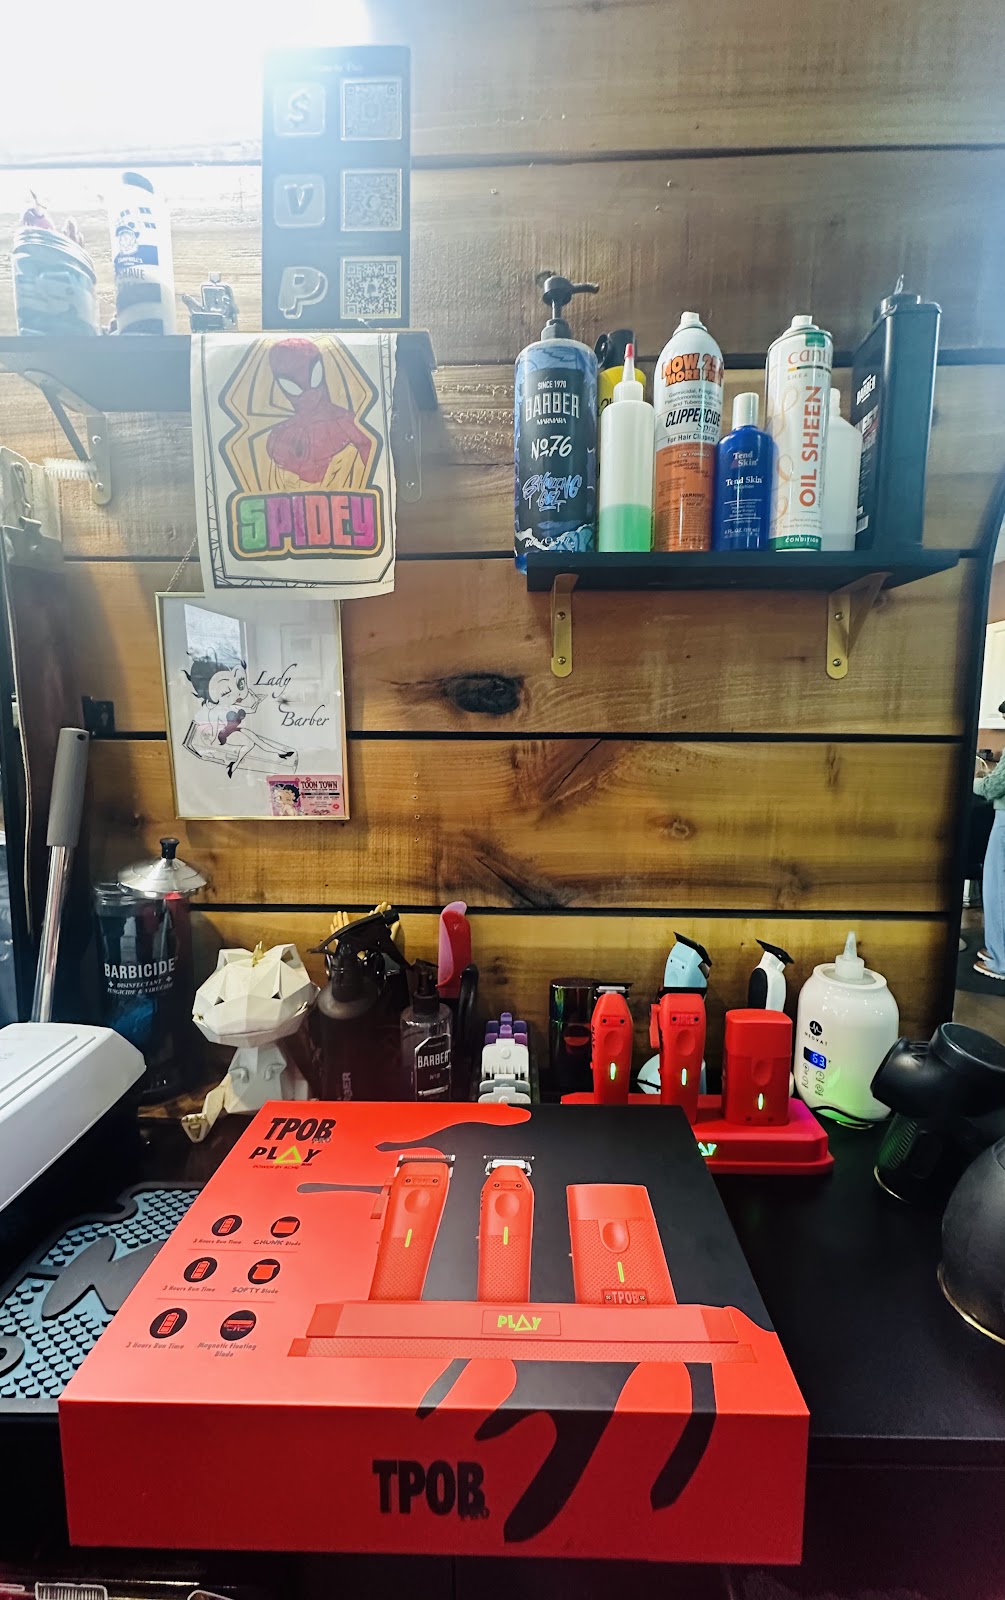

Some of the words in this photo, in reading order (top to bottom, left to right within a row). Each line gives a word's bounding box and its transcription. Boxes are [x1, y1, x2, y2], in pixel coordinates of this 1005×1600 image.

[661, 353, 700, 379] NOW
[537, 381, 553, 390] SINCE
[554, 380, 567, 389] 1970
[666, 369, 700, 387] MORE
[525, 391, 580, 423] BARBER
[801, 385, 822, 462] SHEEN
[667, 436, 676, 444] For
[678, 433, 691, 441] Hair
[733, 451, 753, 460] Tend
[738, 459, 758, 467] Skin
[726, 477, 744, 487] Tend
[745, 475, 763, 484] Skin
[798, 468, 817, 507] OIL
[239, 494, 375, 550] SPIDEY
[253, 663, 298, 698] Lady
[278, 704, 330, 727] Barber
[301, 780, 318, 789] TOON
[318, 780, 338, 789] TOWN
[104, 957, 175, 979] BARBICIDE
[107, 988, 136, 996] FUNGICIDE
[116, 979, 162, 989] DISINFECTANT
[417, 1049, 450, 1069] BARBER
[264, 1117, 337, 1142] TPOB
[248, 1146, 323, 1165] PLAY
[611, 1291, 640, 1304] TPOB
[497, 1314, 542, 1331] PLAY
[197, 1342, 228, 1350] Magnetic
[229, 1343, 257, 1351] Floating
[372, 1459, 486, 1516] TPOB
